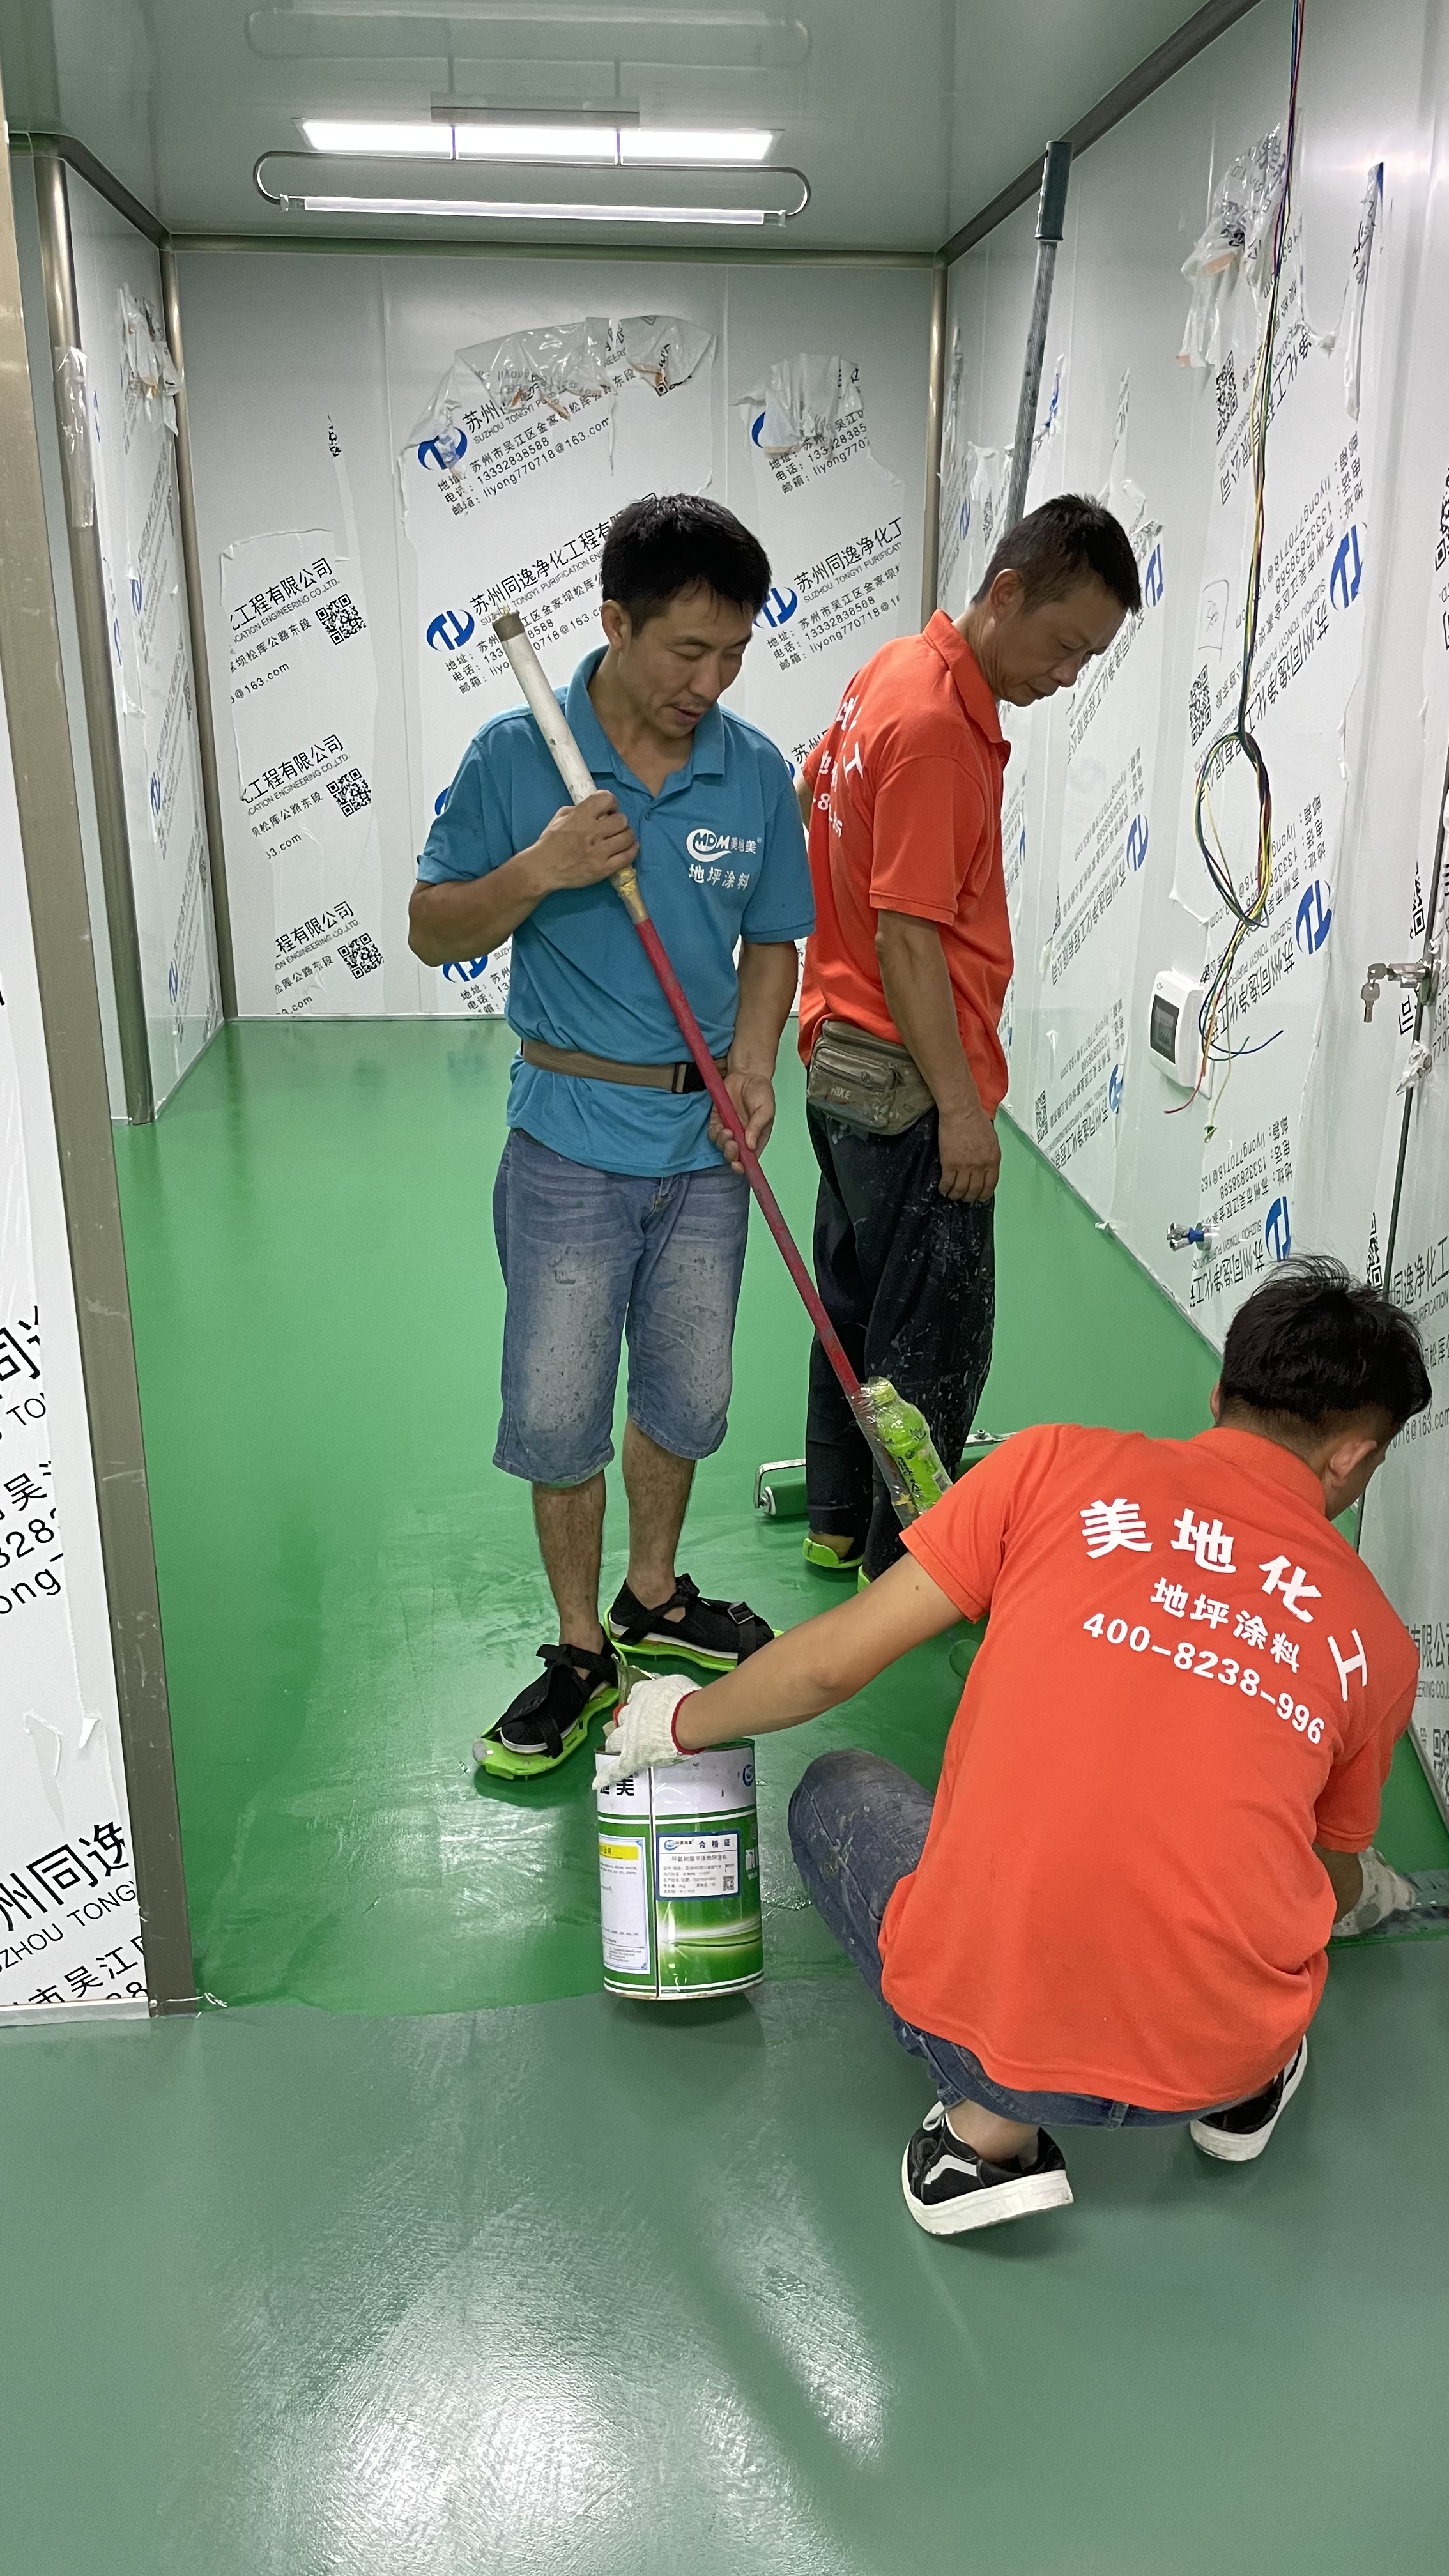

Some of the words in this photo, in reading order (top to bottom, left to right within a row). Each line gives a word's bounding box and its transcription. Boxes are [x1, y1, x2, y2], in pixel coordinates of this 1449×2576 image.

[473, 422, 503, 444] SUZHOU
[506, 404, 534, 425] TONGYI
[477, 437, 549, 484] 13332838588
[1275, 502, 1332, 594] 13332838588
[512, 588, 539, 607] TONGYI
[541, 558, 589, 591] PURIFICATION
[803, 582, 834, 604] SUZHOU
[836, 567, 862, 585] TONGYI
[1301, 579, 1326, 619] SUZHOU
[262, 594, 309, 627] ENGINEERING
[804, 595, 875, 641] 13332838588
[231, 663, 289, 703] @163.com
[689, 863, 750, 890] 地坪涂料
[1269, 917, 1292, 947] SUZHOU
[1249, 941, 1268, 969] TONGYI
[1220, 1156, 1267, 1200] 13332838588
[1150, 1577, 1300, 1674] 地坪涂料
[1082, 1613, 1325, 1744] 400-8238-996
[0, 1923, 63, 1972] ZHOU
[66, 1881, 136, 1927] TONG
